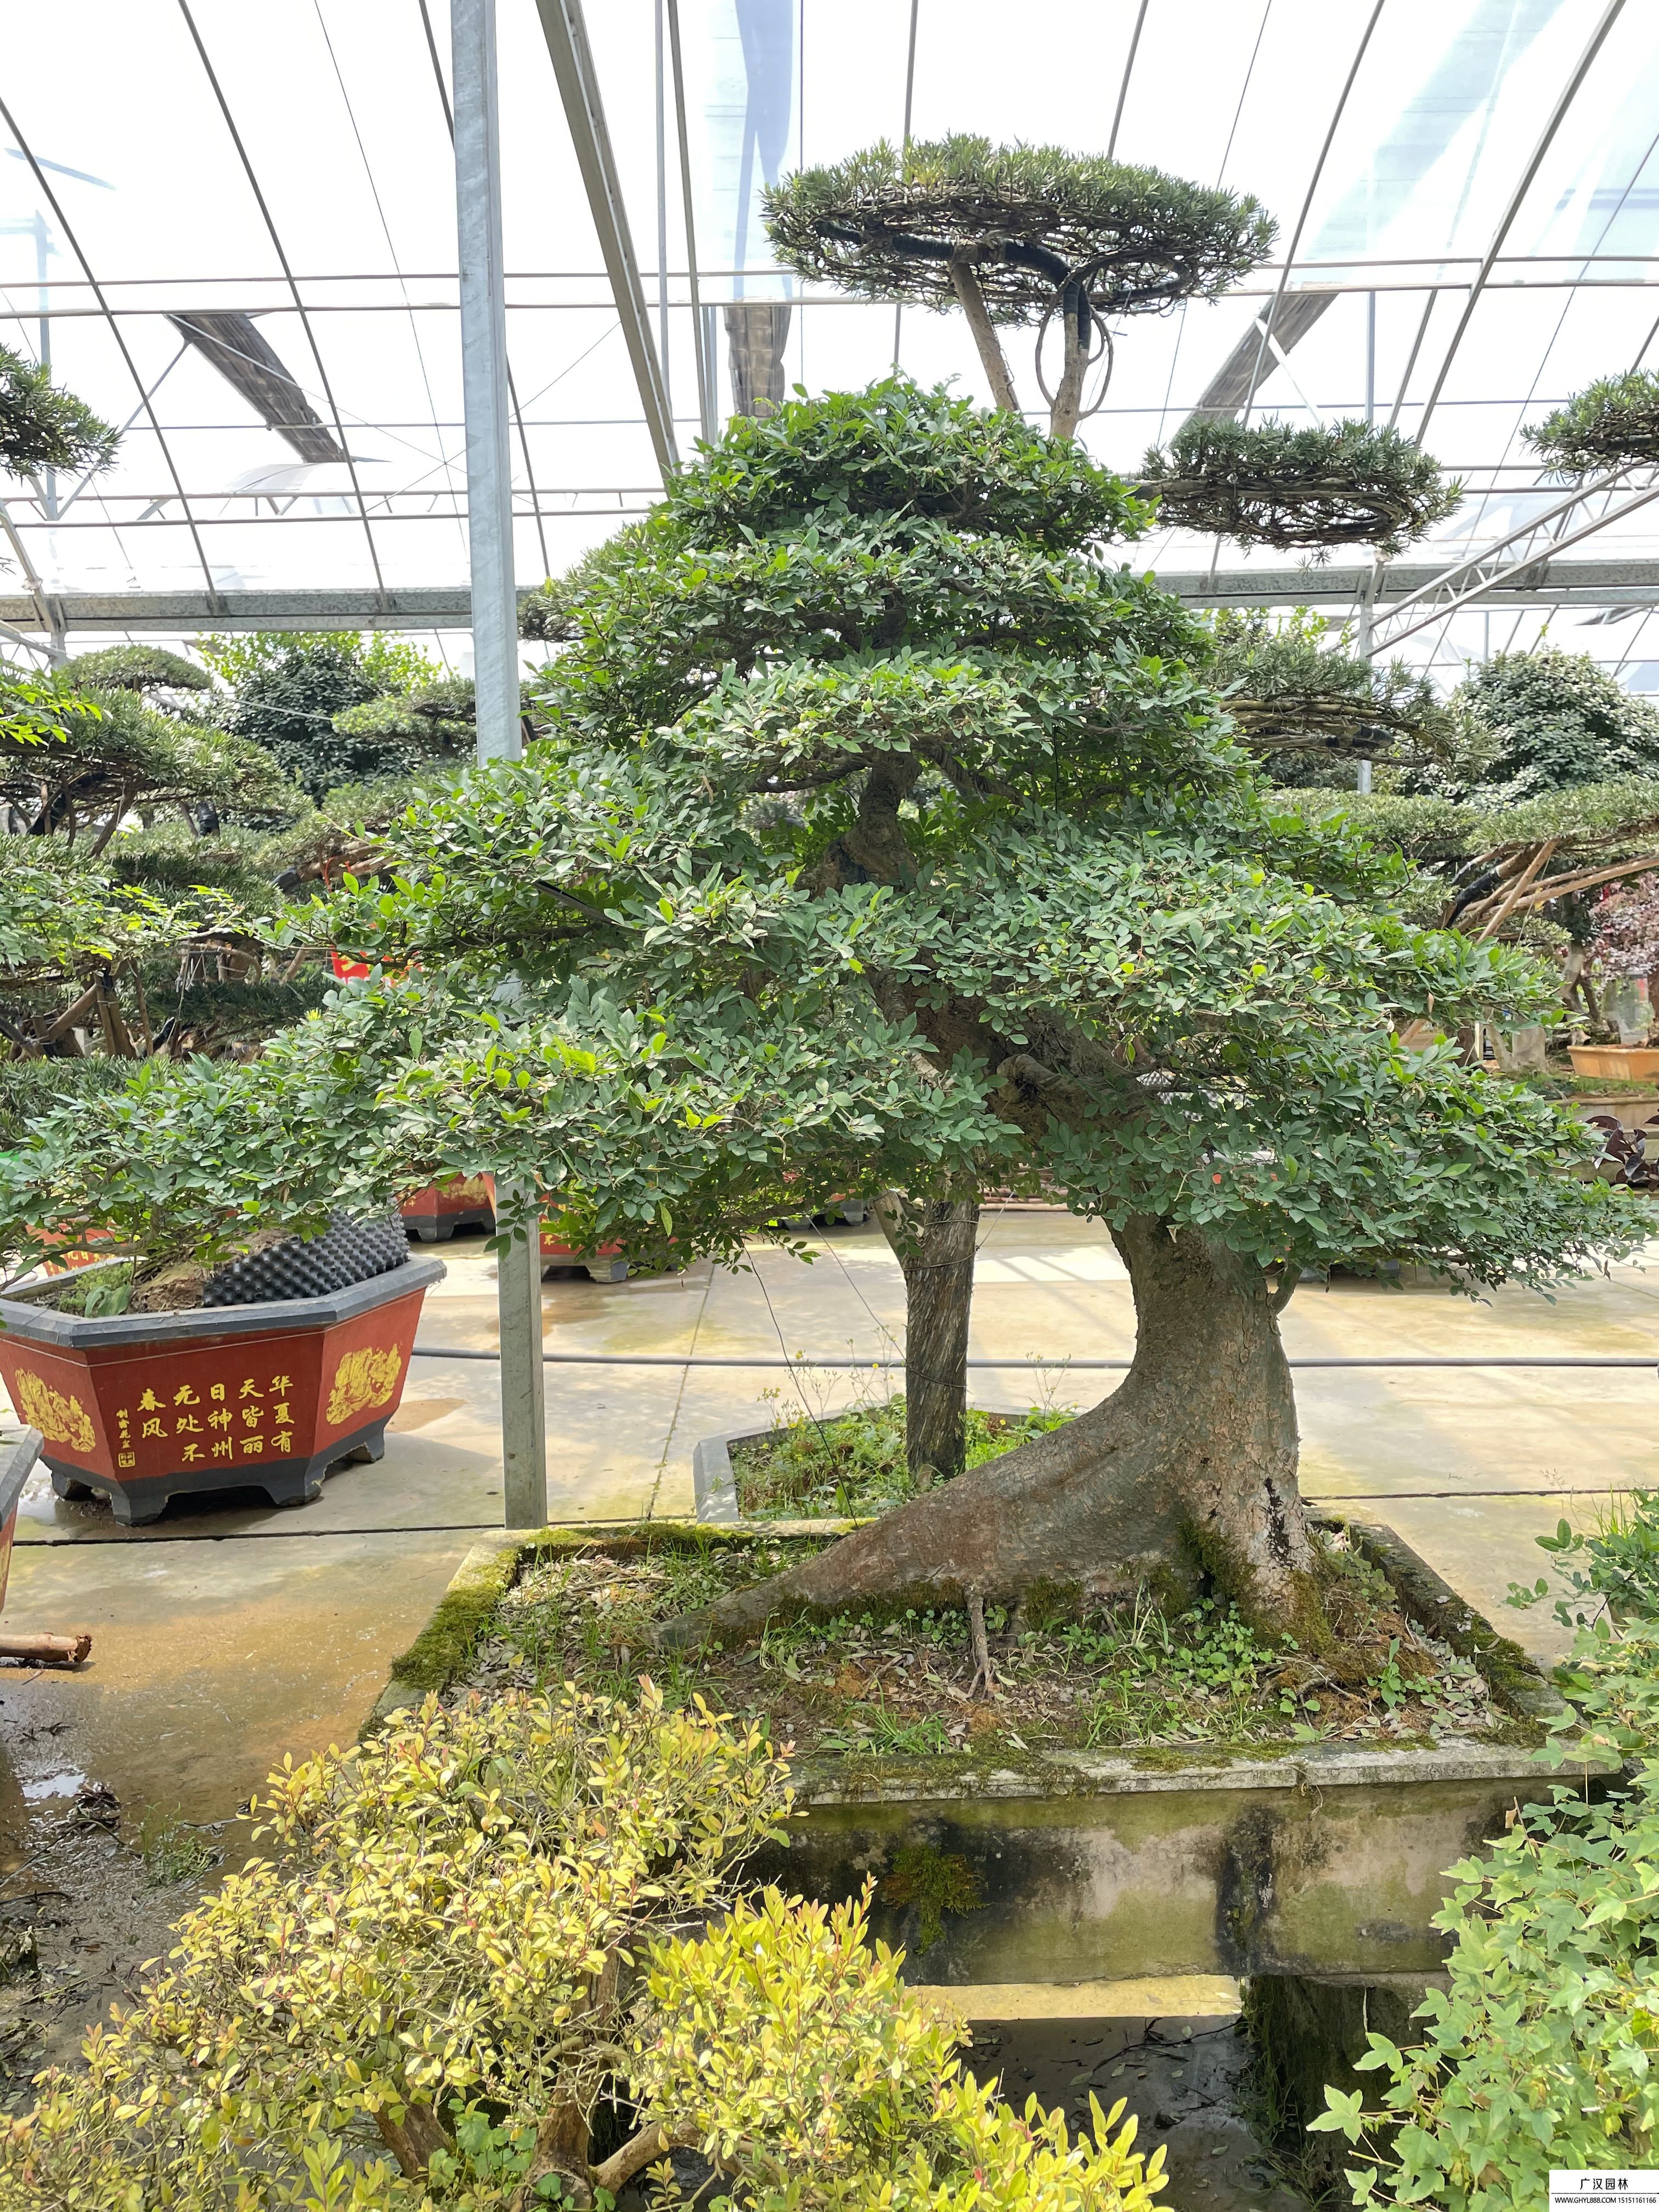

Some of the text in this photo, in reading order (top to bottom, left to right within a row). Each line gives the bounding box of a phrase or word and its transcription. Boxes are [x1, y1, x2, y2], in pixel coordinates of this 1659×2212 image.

[137, 1388, 168, 1438] 春风
[173, 1385, 205, 1462] 无处不
[207, 1383, 233, 1460] 日神州
[238, 1379, 264, 1454] 天皆丽
[269, 1375, 295, 1453] 华夏有
